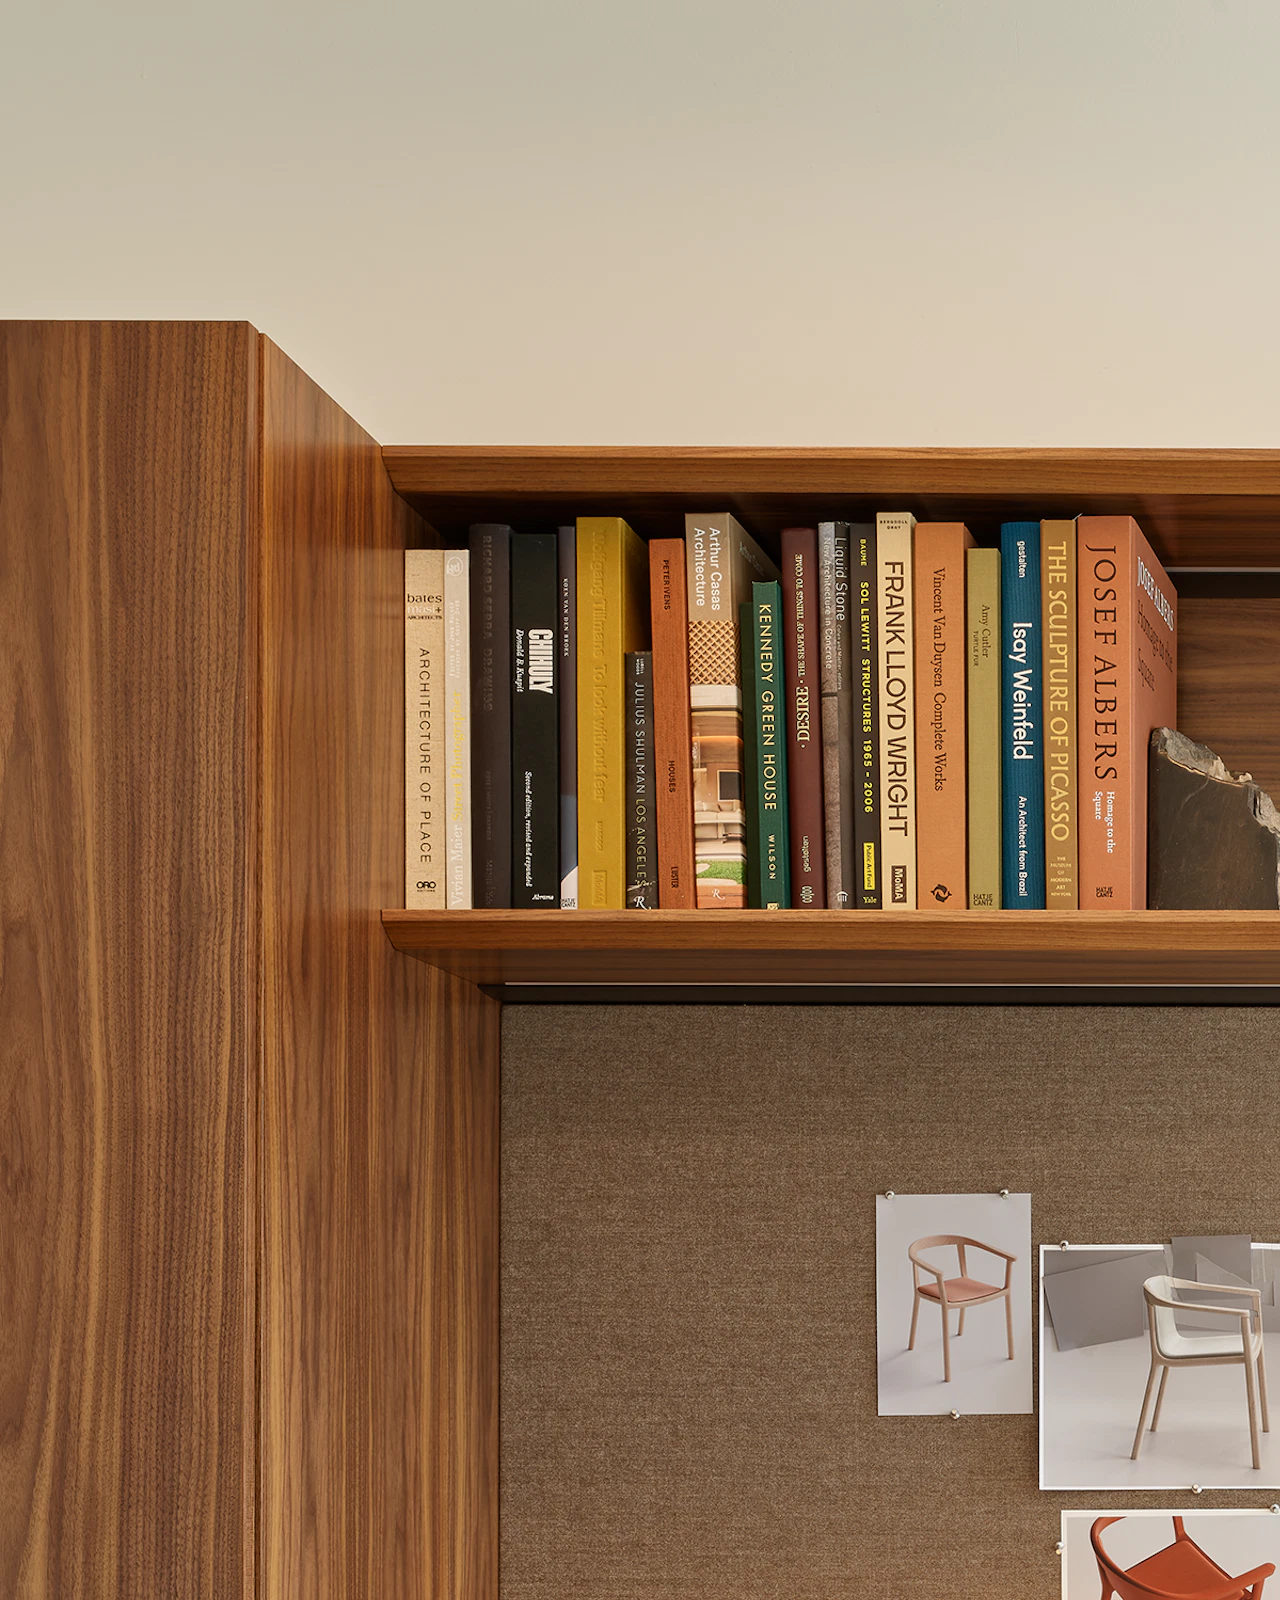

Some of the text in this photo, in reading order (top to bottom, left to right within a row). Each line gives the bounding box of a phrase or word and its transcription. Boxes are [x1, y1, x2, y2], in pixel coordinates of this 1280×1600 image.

[591, 530, 607, 596] Wolfgang
[693, 527, 707, 606] Architecture
[709, 527, 723, 611] Arthur Casas
[834, 536, 848, 578] Liquid
[859, 538, 867, 567] BAUME
[1017, 540, 1027, 578] gestalten
[1137, 556, 1154, 601] JOSEF
[407, 593, 442, 603] bates
[663, 559, 671, 611] PETER IVENS
[823, 537, 834, 669] New Architecture in Concrete
[835, 582, 848, 621] Stone
[860, 581, 870, 605] SOL
[482, 535, 494, 713] RICHARD SERRA DRAWING
[562, 577, 570, 657] KOEN VAN DEN BROEK
[592, 598, 607, 658] Tillmans
[860, 608, 871, 652] LEWITT
[979, 604, 991, 658] Amy Cutler
[515, 629, 525, 693] Donald B. Kuspit
[528, 628, 554, 695] CHIHULY
[593, 663, 607, 683] To
[795, 554, 810, 742] DESIRE THE SHAPE OF THINGS TO COME
[1085, 543, 1118, 781] JOSEF ALBERS
[593, 684, 608, 715] look
[759, 604, 777, 810] KENNEDY GREEN HOUSE
[861, 658, 872, 732] STRUCTURES
[885, 561, 908, 837] FRANK LLOYD WRIGHT
[930, 567, 948, 792] Vincent Van Duysen Complete Works
[1008, 622, 1034, 760] Isay Weinfeld
[1048, 541, 1071, 842] THE SCULPTURE OF PICASSO
[418, 648, 432, 863] ARCHITECTURE OF PLACE
[593, 717, 608, 772] without
[863, 739, 872, 767] 1965
[449, 689, 465, 905] Vivian Maier Street Photographer
[593, 773, 608, 803] fear
[634, 681, 647, 886] JULIUS SHULMAN LOS ANGELES
[668, 760, 676, 793] HOUSES
[863, 781, 873, 814] 2006
[1092, 790, 1103, 820] Square
[524, 770, 533, 887] Second edition, revised and expanded
[1018, 796, 1028, 897] An Architect from Brazil
[1104, 790, 1116, 853] Homage to the
[670, 866, 679, 888] LUSTER
[768, 834, 776, 880] WILSON
[802, 835, 811, 873] gestalten
[894, 868, 904, 900] MoMA
